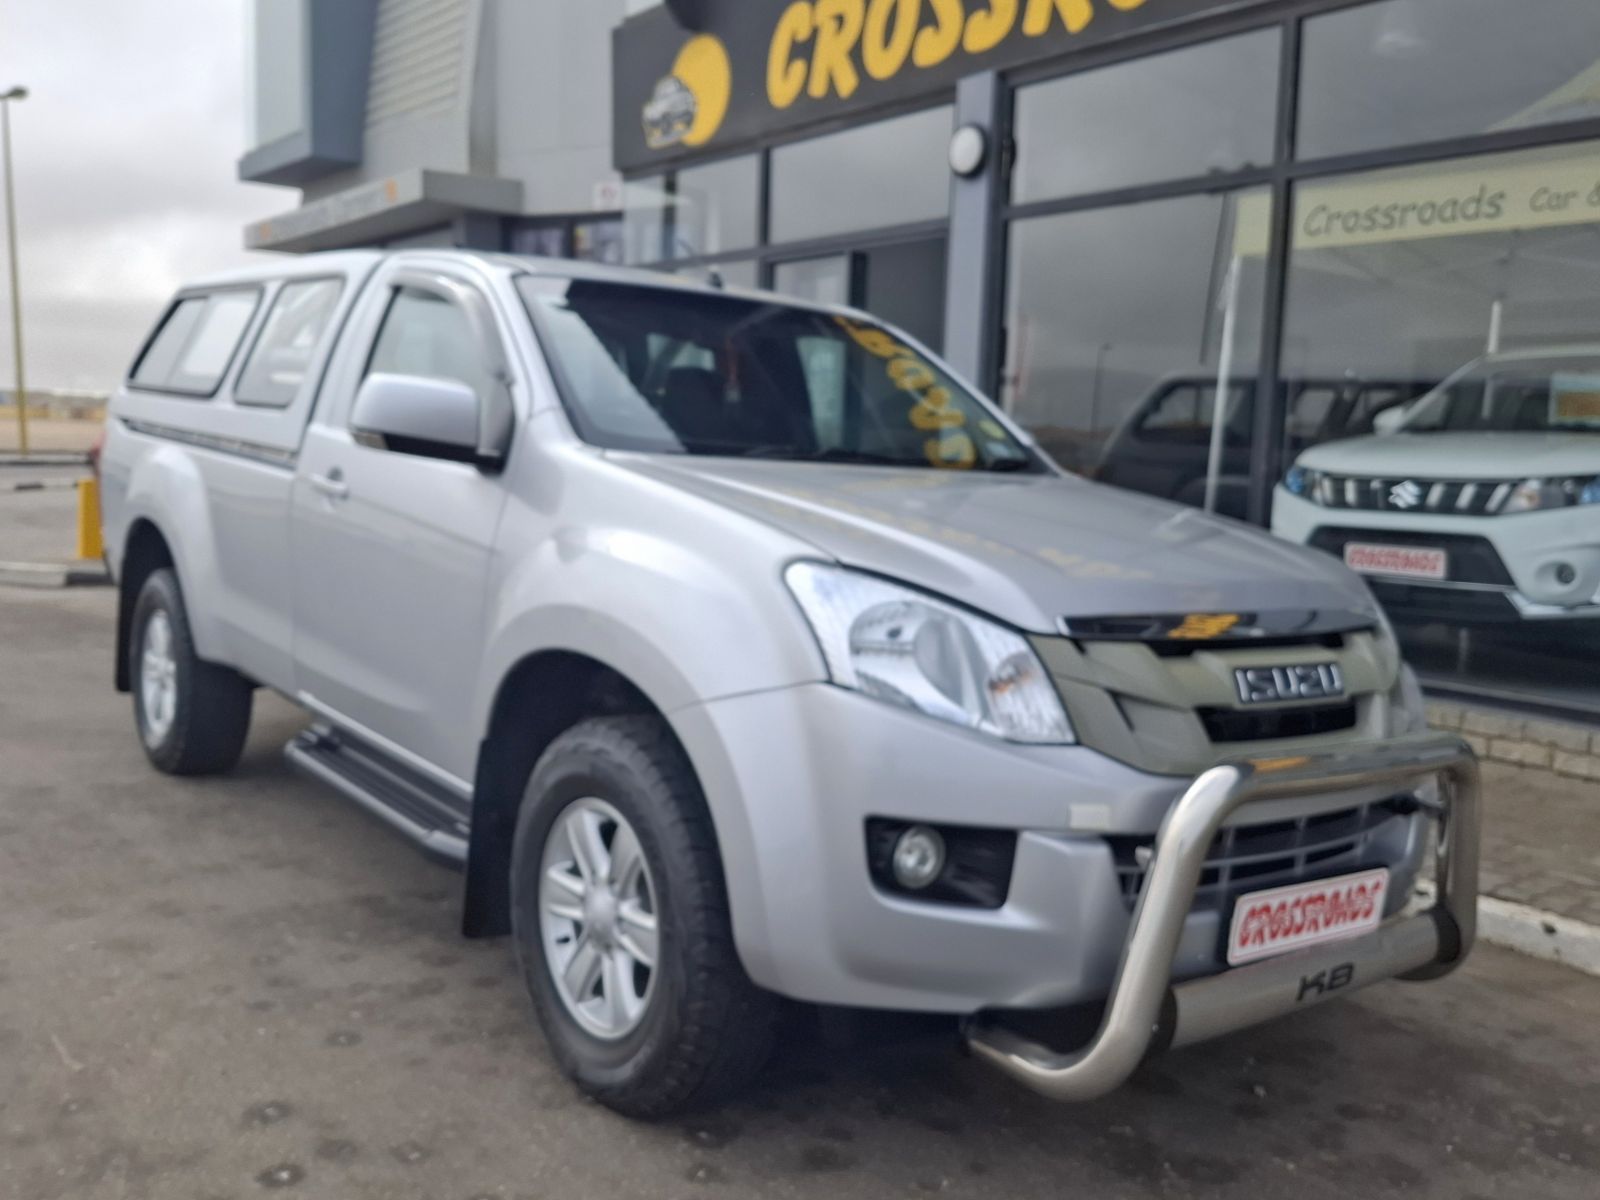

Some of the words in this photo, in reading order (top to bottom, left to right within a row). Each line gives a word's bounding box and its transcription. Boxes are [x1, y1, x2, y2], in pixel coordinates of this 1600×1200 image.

[766, 0, 1148, 108] CROS
[1303, 183, 1506, 237] Crossroads
[1529, 187, 1579, 212] Car
[1235, 663, 1343, 702] ISUZU
[1238, 880, 1382, 947] CROSSROADS
